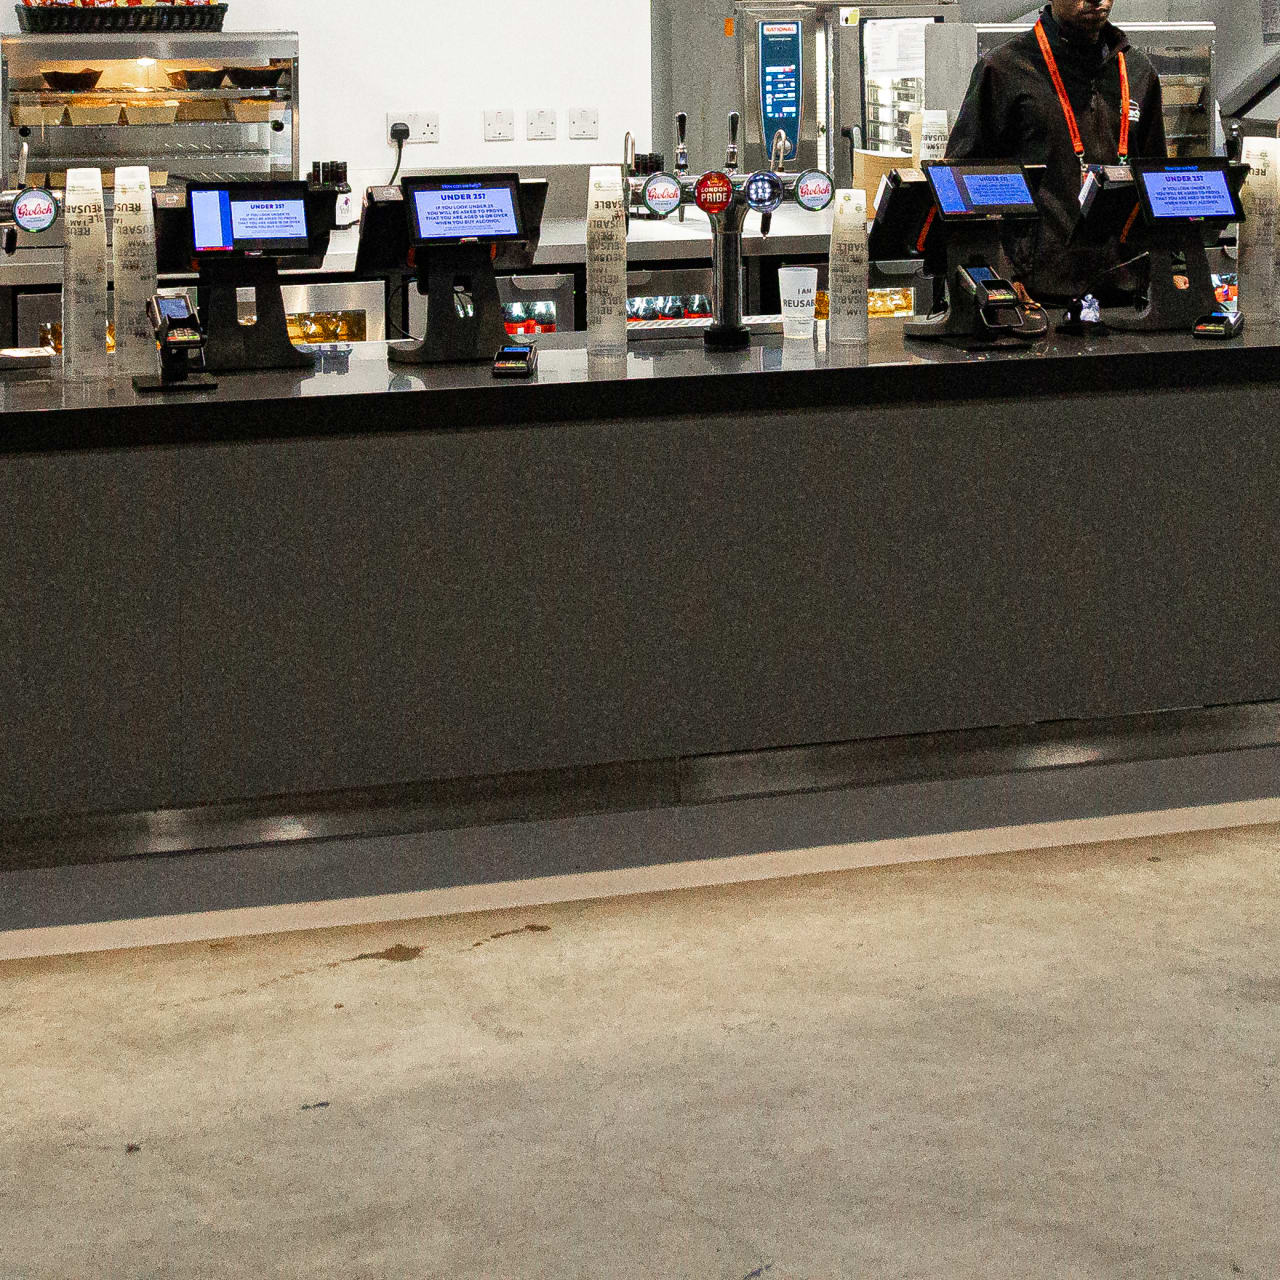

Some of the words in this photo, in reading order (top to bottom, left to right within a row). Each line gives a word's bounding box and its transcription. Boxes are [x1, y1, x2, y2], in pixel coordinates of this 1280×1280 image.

[648, 188, 678, 200] Grolsch
[800, 183, 830, 197] Grolsch
[701, 193, 727, 202] PRIDE
[17, 203, 53, 219] Grolsch
